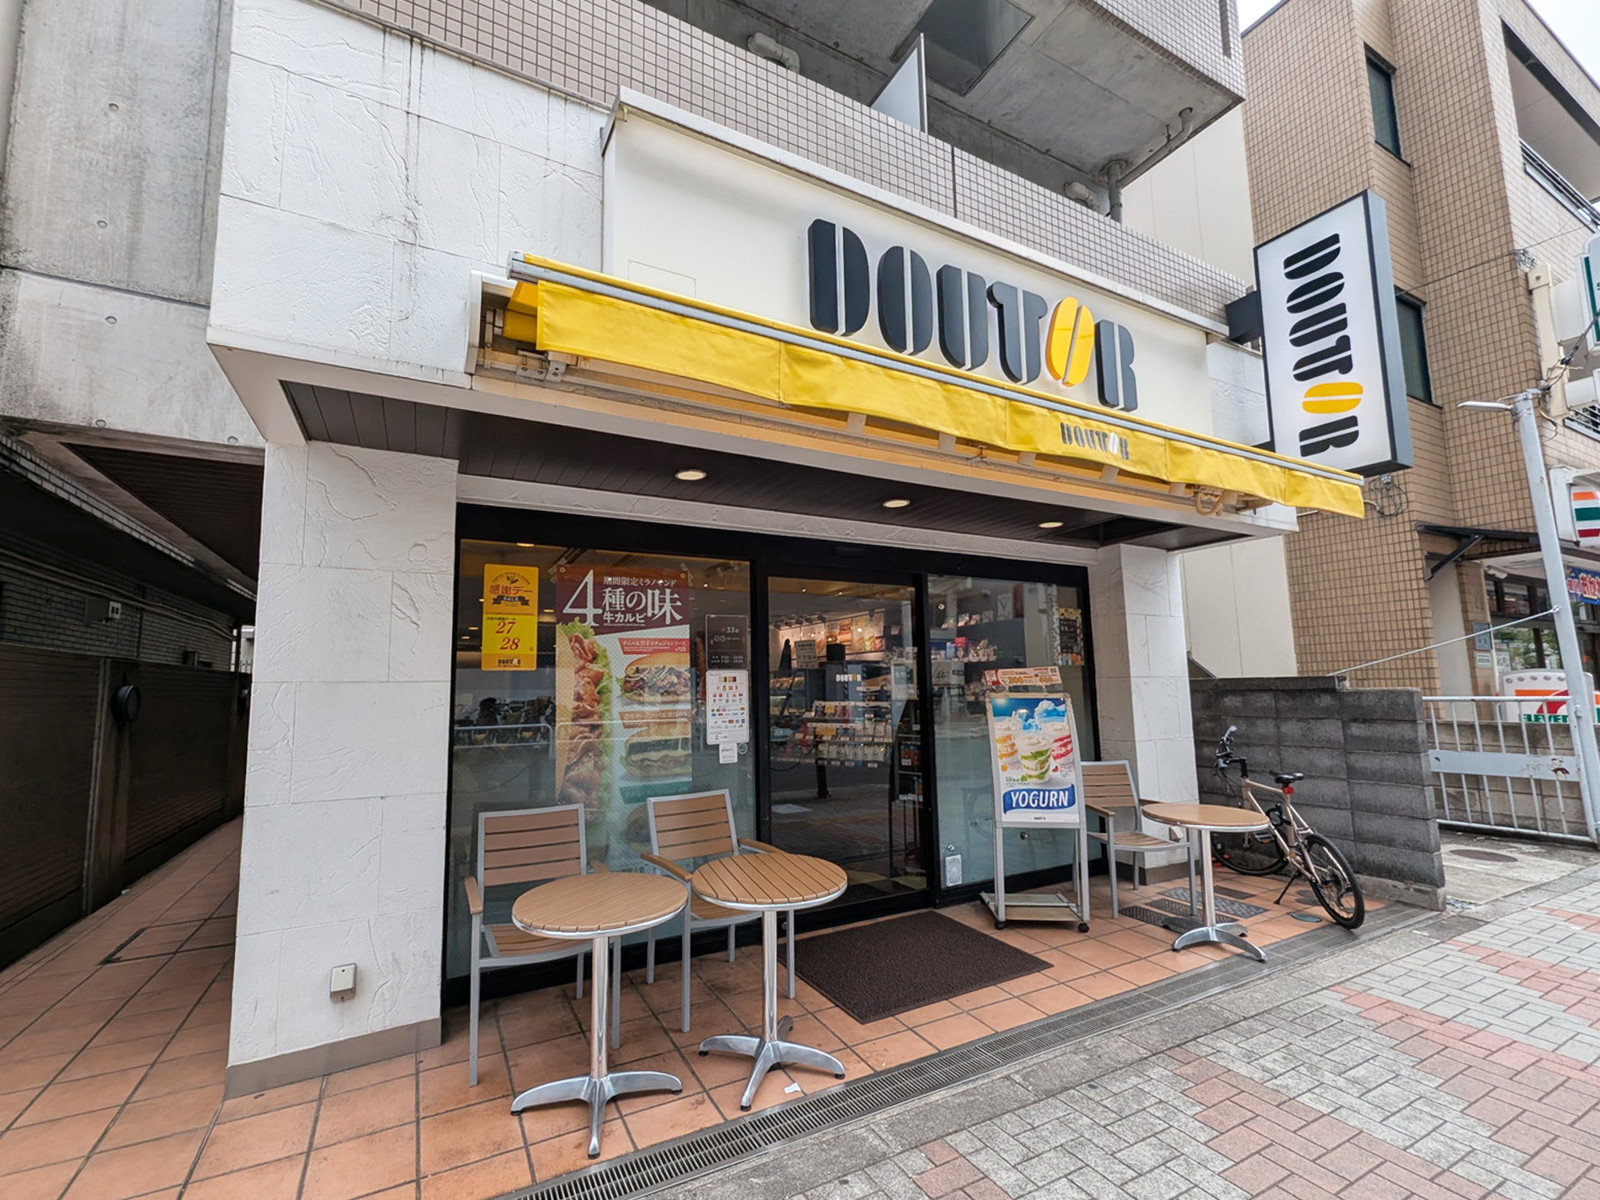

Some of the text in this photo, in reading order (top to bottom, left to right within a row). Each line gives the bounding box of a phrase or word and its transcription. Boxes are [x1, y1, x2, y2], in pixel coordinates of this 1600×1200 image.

[808, 218, 1139, 412] DOUTOR
[1284, 233, 1363, 457] DOUTOR
[1060, 422, 1129, 460] DOUTOR
[489, 584, 533, 595] 感謝デー
[562, 569, 683, 626] 4種の味
[603, 612, 646, 623] 牛カルビ
[496, 621, 516, 634] 27
[500, 637, 520, 650] 28
[1011, 791, 1069, 808] YOGURN
